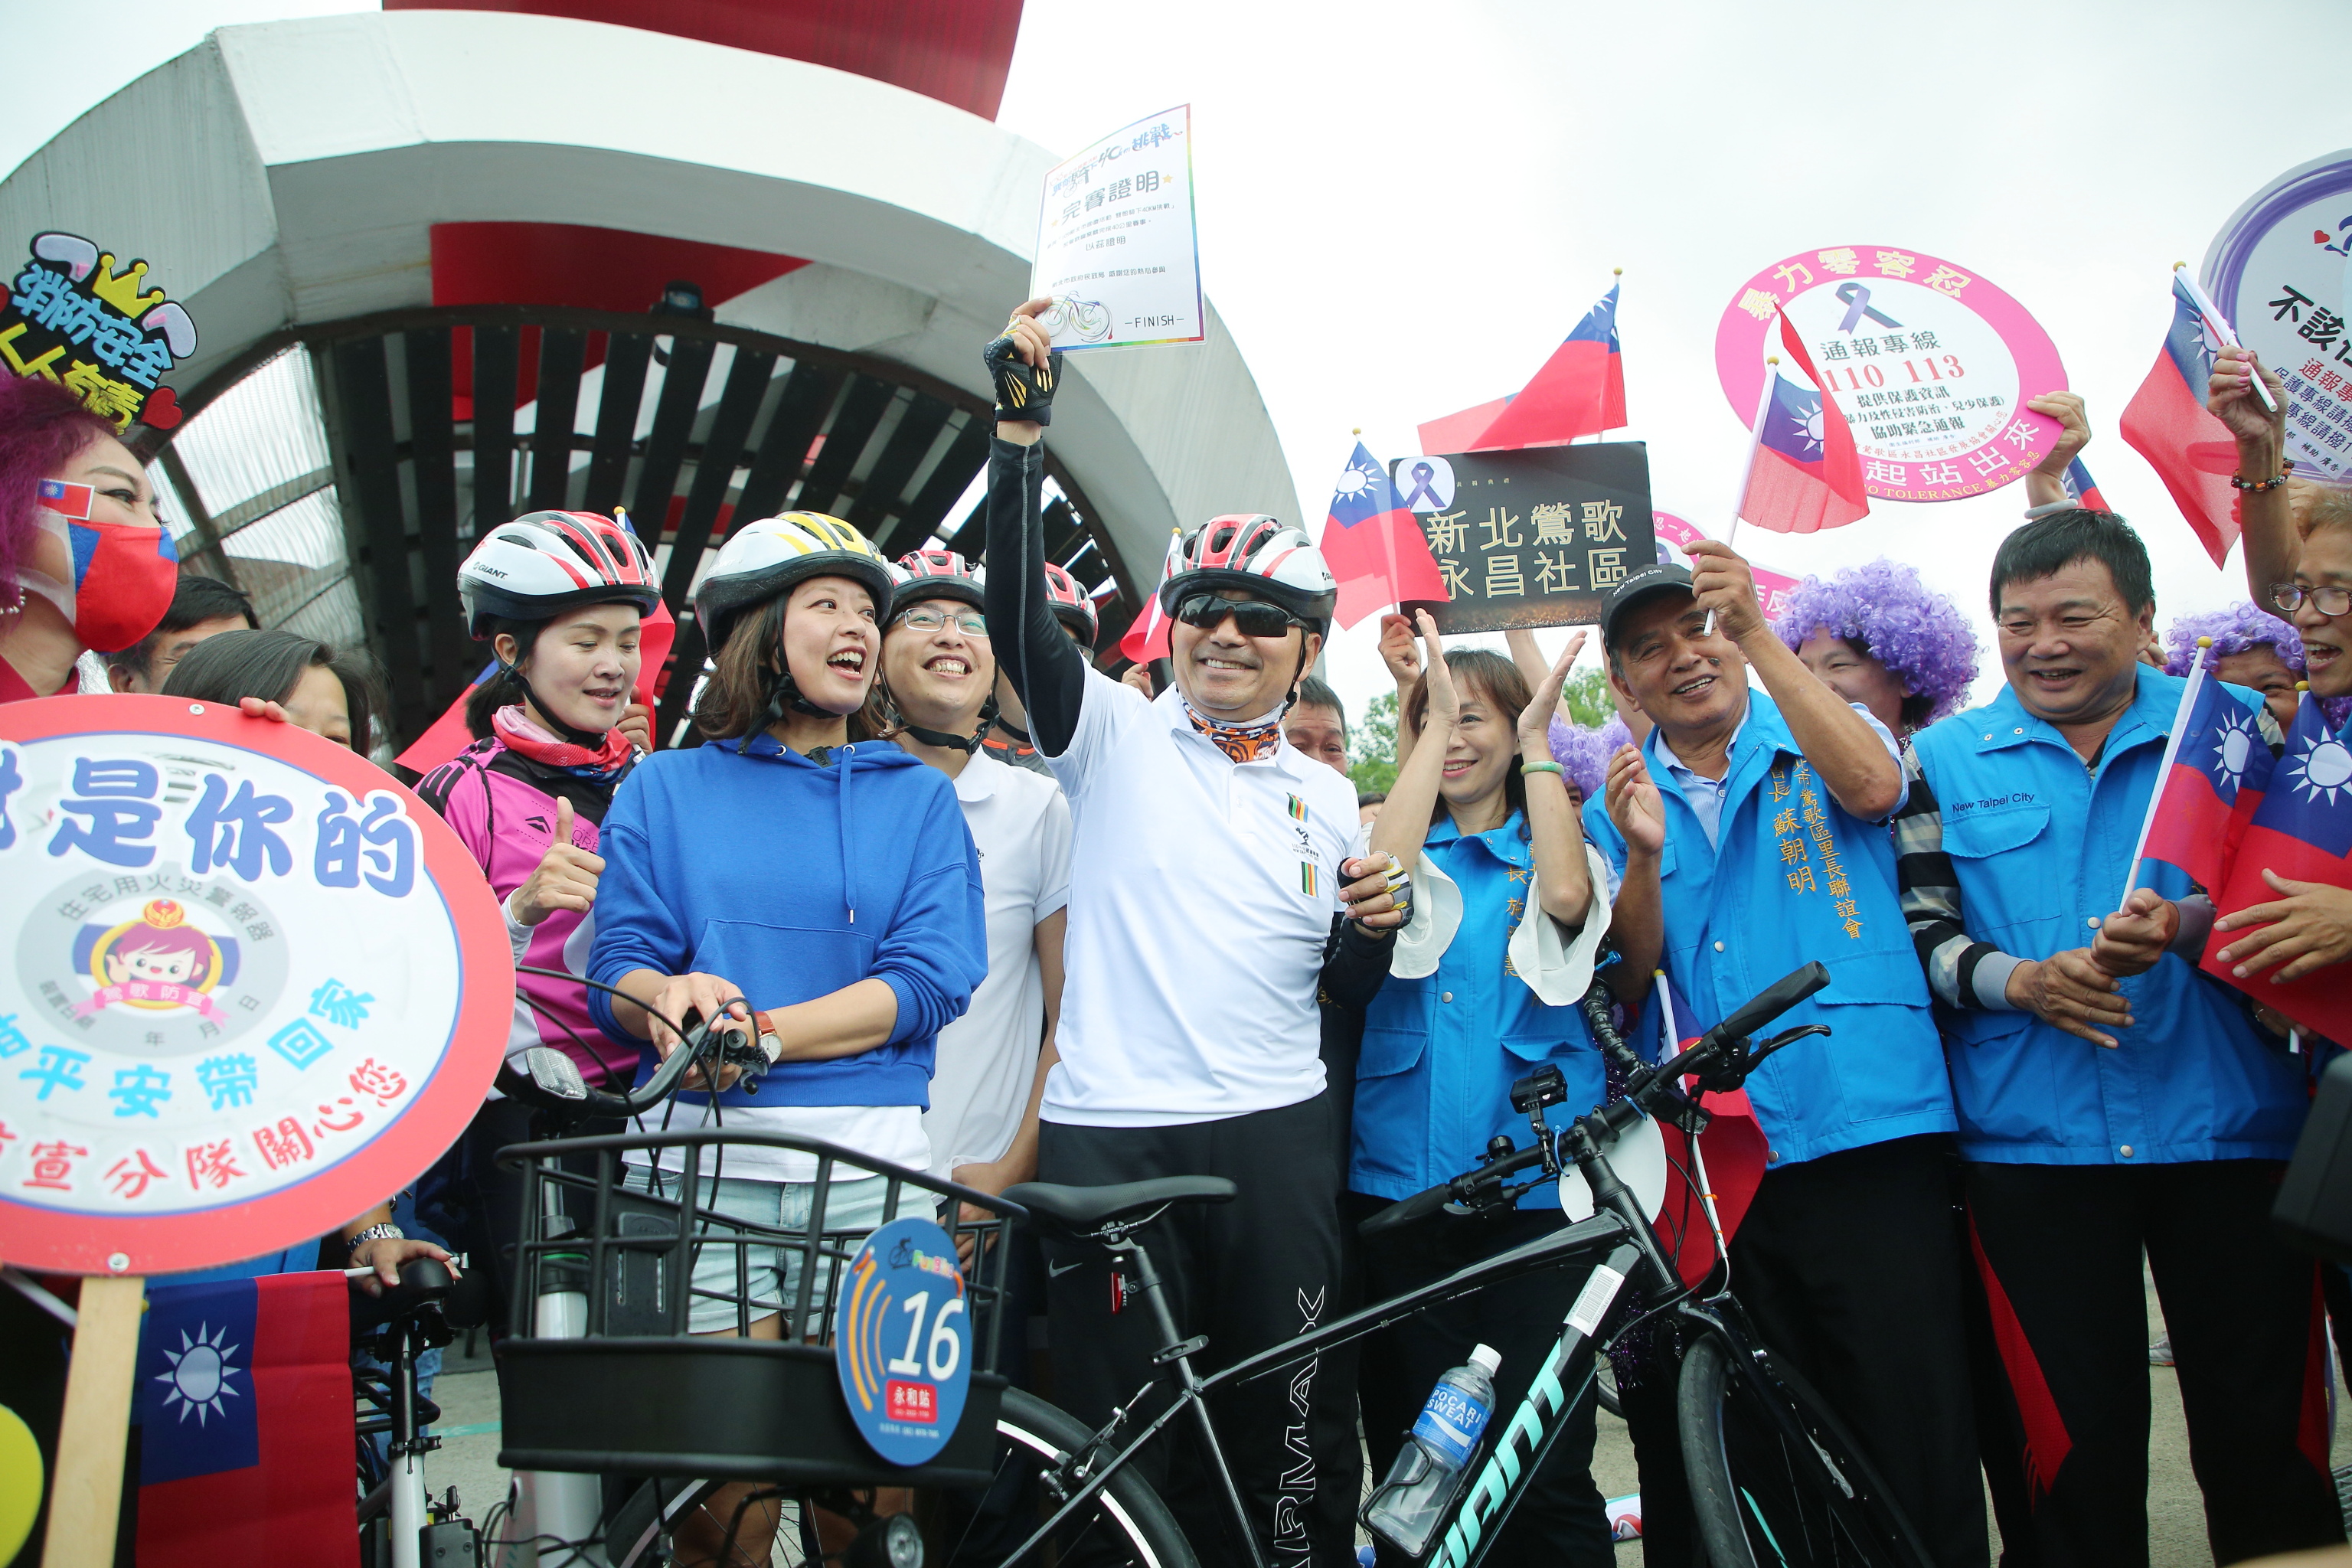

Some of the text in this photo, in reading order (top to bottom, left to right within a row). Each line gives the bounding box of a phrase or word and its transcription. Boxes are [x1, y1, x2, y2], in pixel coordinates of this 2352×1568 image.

[1062, 170, 1159, 225] 完賽證明
[1737, 247, 1972, 321] 暴力零容忍
[1819, 330, 1942, 362] 通報專線
[1822, 354, 1965, 393] 110 113
[1857, 385, 1951, 409] 提供保護資訊
[1870, 416, 1966, 439] 協助緊急通報
[1883, 482, 1984, 500] TOLERANCE
[1426, 499, 1628, 554] 新北鶯歌
[479, 564, 508, 580] GIANT
[1437, 547, 1628, 600] 永昌社區
[1612, 585, 1625, 597] New
[1625, 572, 1647, 586] Taipei
[1952, 792, 2035, 814] New Taipei City
[1772, 808, 1817, 896] 蘇朝明
[0, 1057, 409, 1200] 宣分隊關心您
[888, 1290, 965, 1382] 16
[893, 1385, 931, 1409] 永和站
[1426, 1398, 1474, 1429] SWEAT
[1432, 1389, 1482, 1423] POCARI
[1428, 1337, 1565, 1568] IANT
